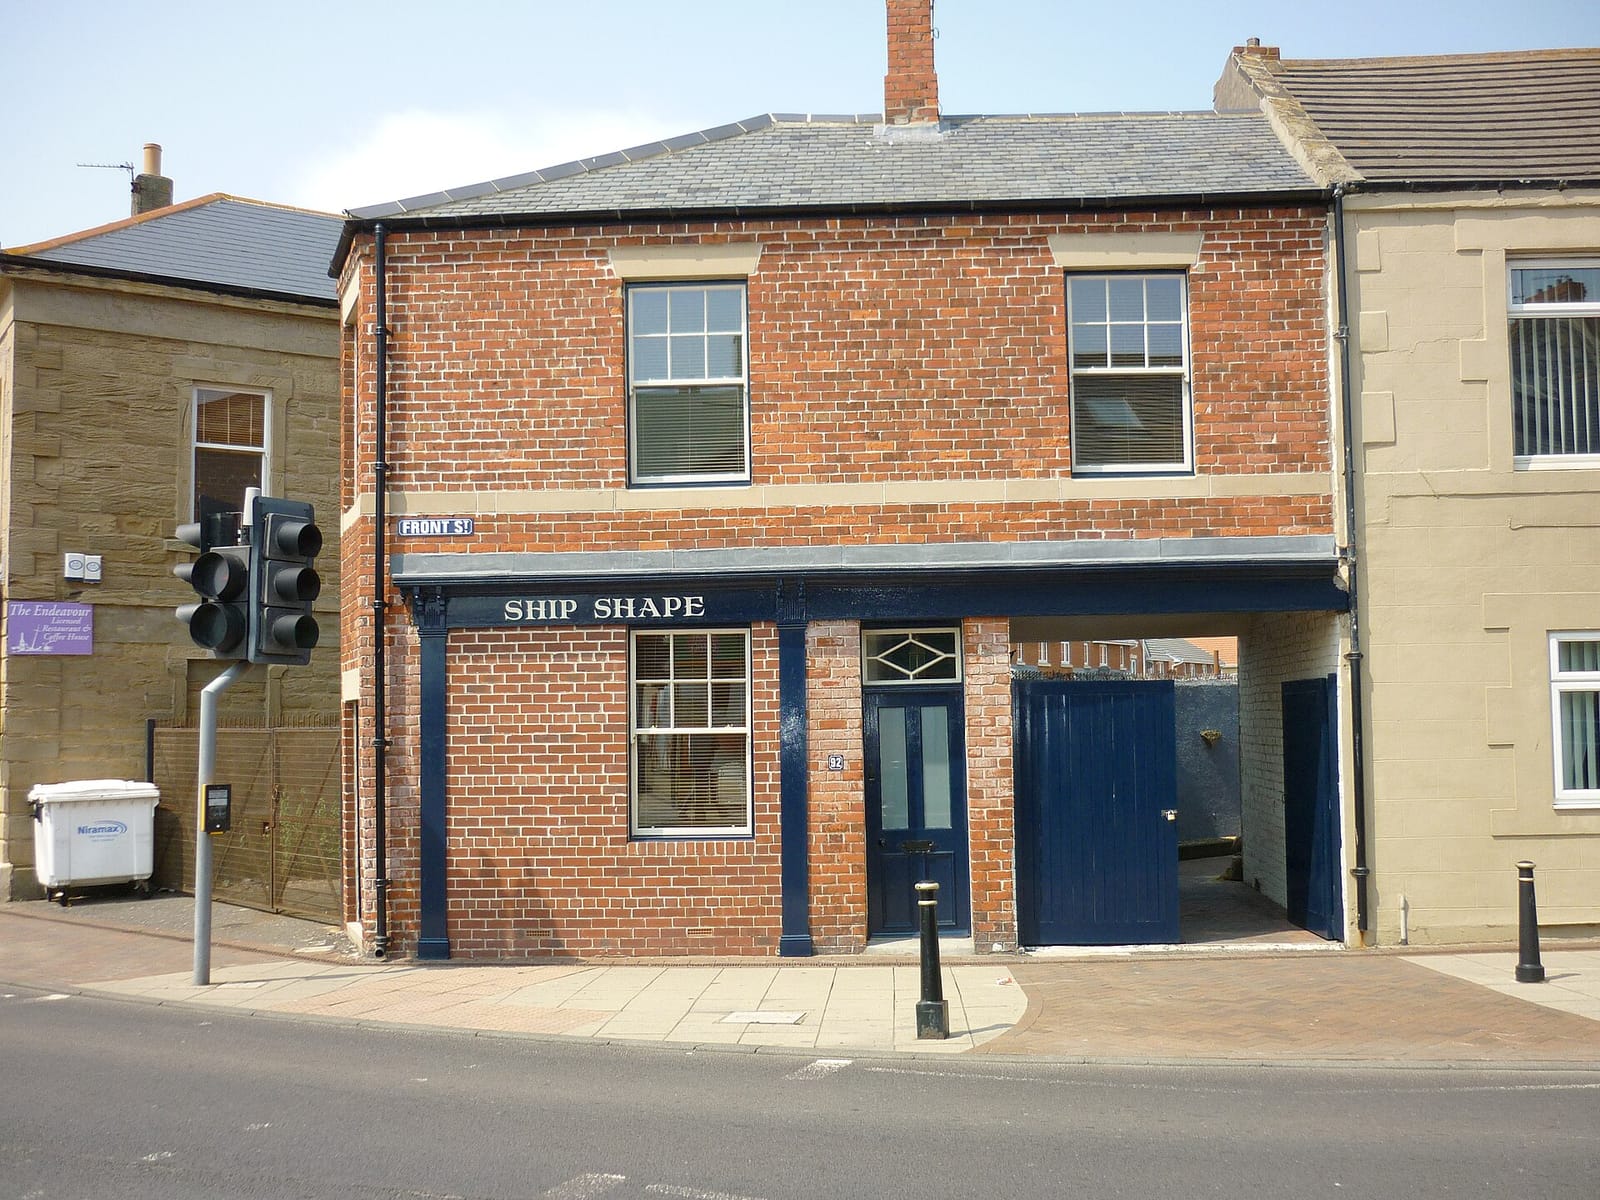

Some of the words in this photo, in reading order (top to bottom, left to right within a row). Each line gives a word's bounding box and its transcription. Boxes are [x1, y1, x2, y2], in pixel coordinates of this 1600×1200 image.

[402, 520, 450, 534] FRONT
[10, 604, 32, 616] The
[34, 604, 91, 616] Endeavour
[504, 599, 578, 621] SHIP
[593, 596, 705, 619] SHAPE
[42, 624, 81, 632] Restaurant
[82, 624, 92, 632] &
[43, 632, 66, 641] Coffee
[67, 632, 90, 641] House
[830, 757, 841, 768] 92
[78, 825, 119, 834] Niramax
